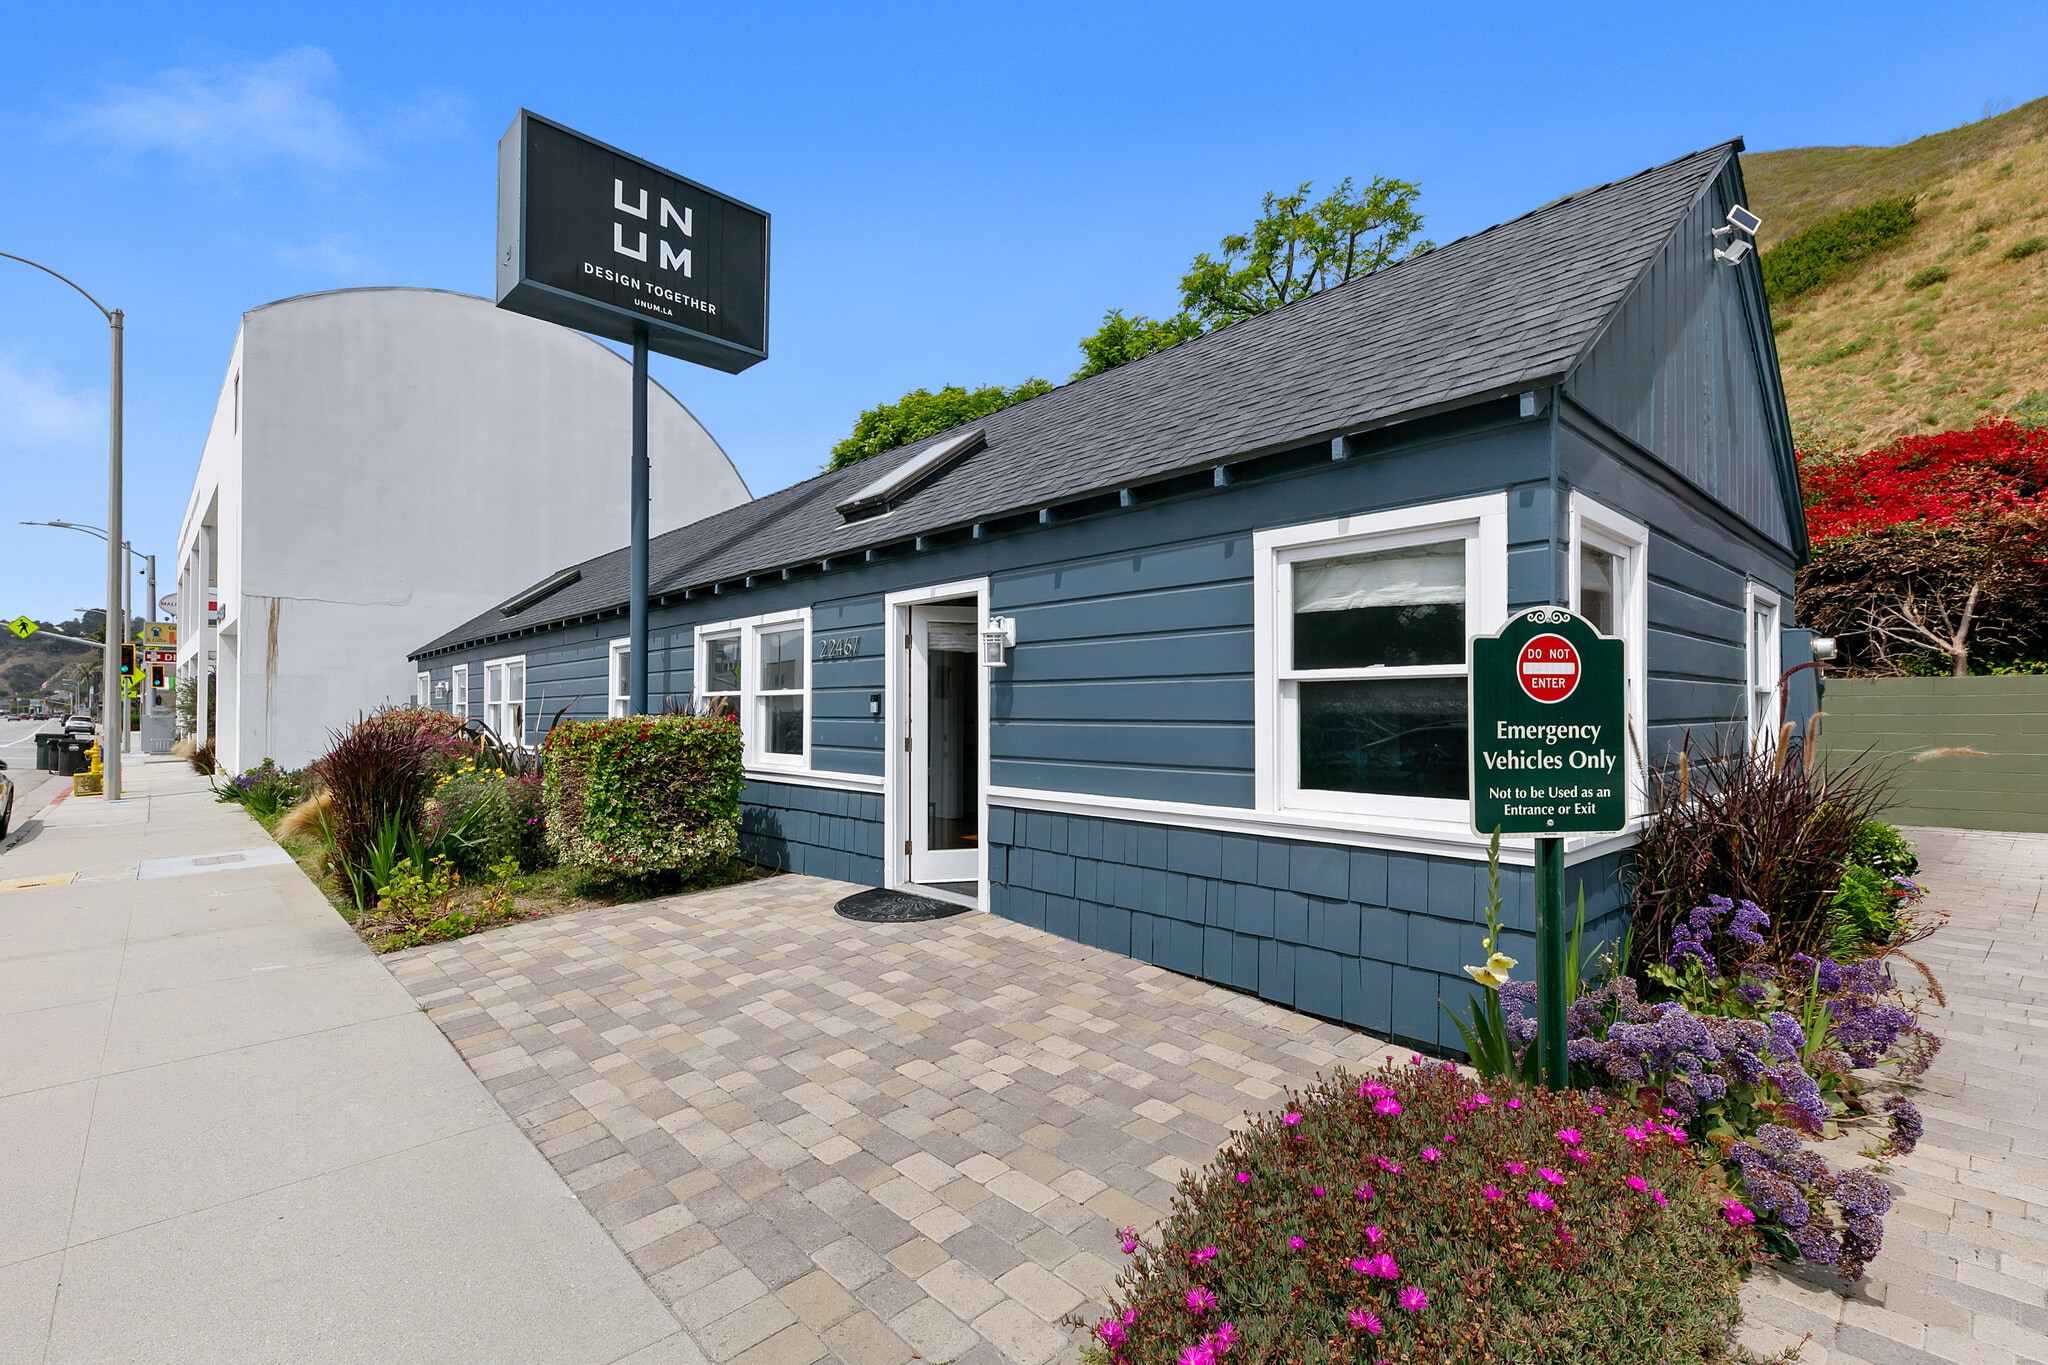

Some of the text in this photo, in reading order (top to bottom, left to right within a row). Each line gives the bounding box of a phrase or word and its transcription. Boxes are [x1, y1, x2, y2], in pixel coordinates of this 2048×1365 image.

[614, 178, 693, 238] UN
[613, 222, 692, 279] UM
[584, 261, 717, 316] DESIGN TOGETHER
[633, 298, 673, 317] UNUM.LA
[820, 635, 860, 658] 22467
[1527, 648, 1570, 659] DO NOT
[1531, 677, 1566, 688] ENTER
[1497, 720, 1601, 745] Emergency
[1482, 749, 1617, 775] Vehicles Only
[1489, 786, 1611, 799] Not to be Used as an
[1504, 802, 1596, 816] Entrance or Exit
